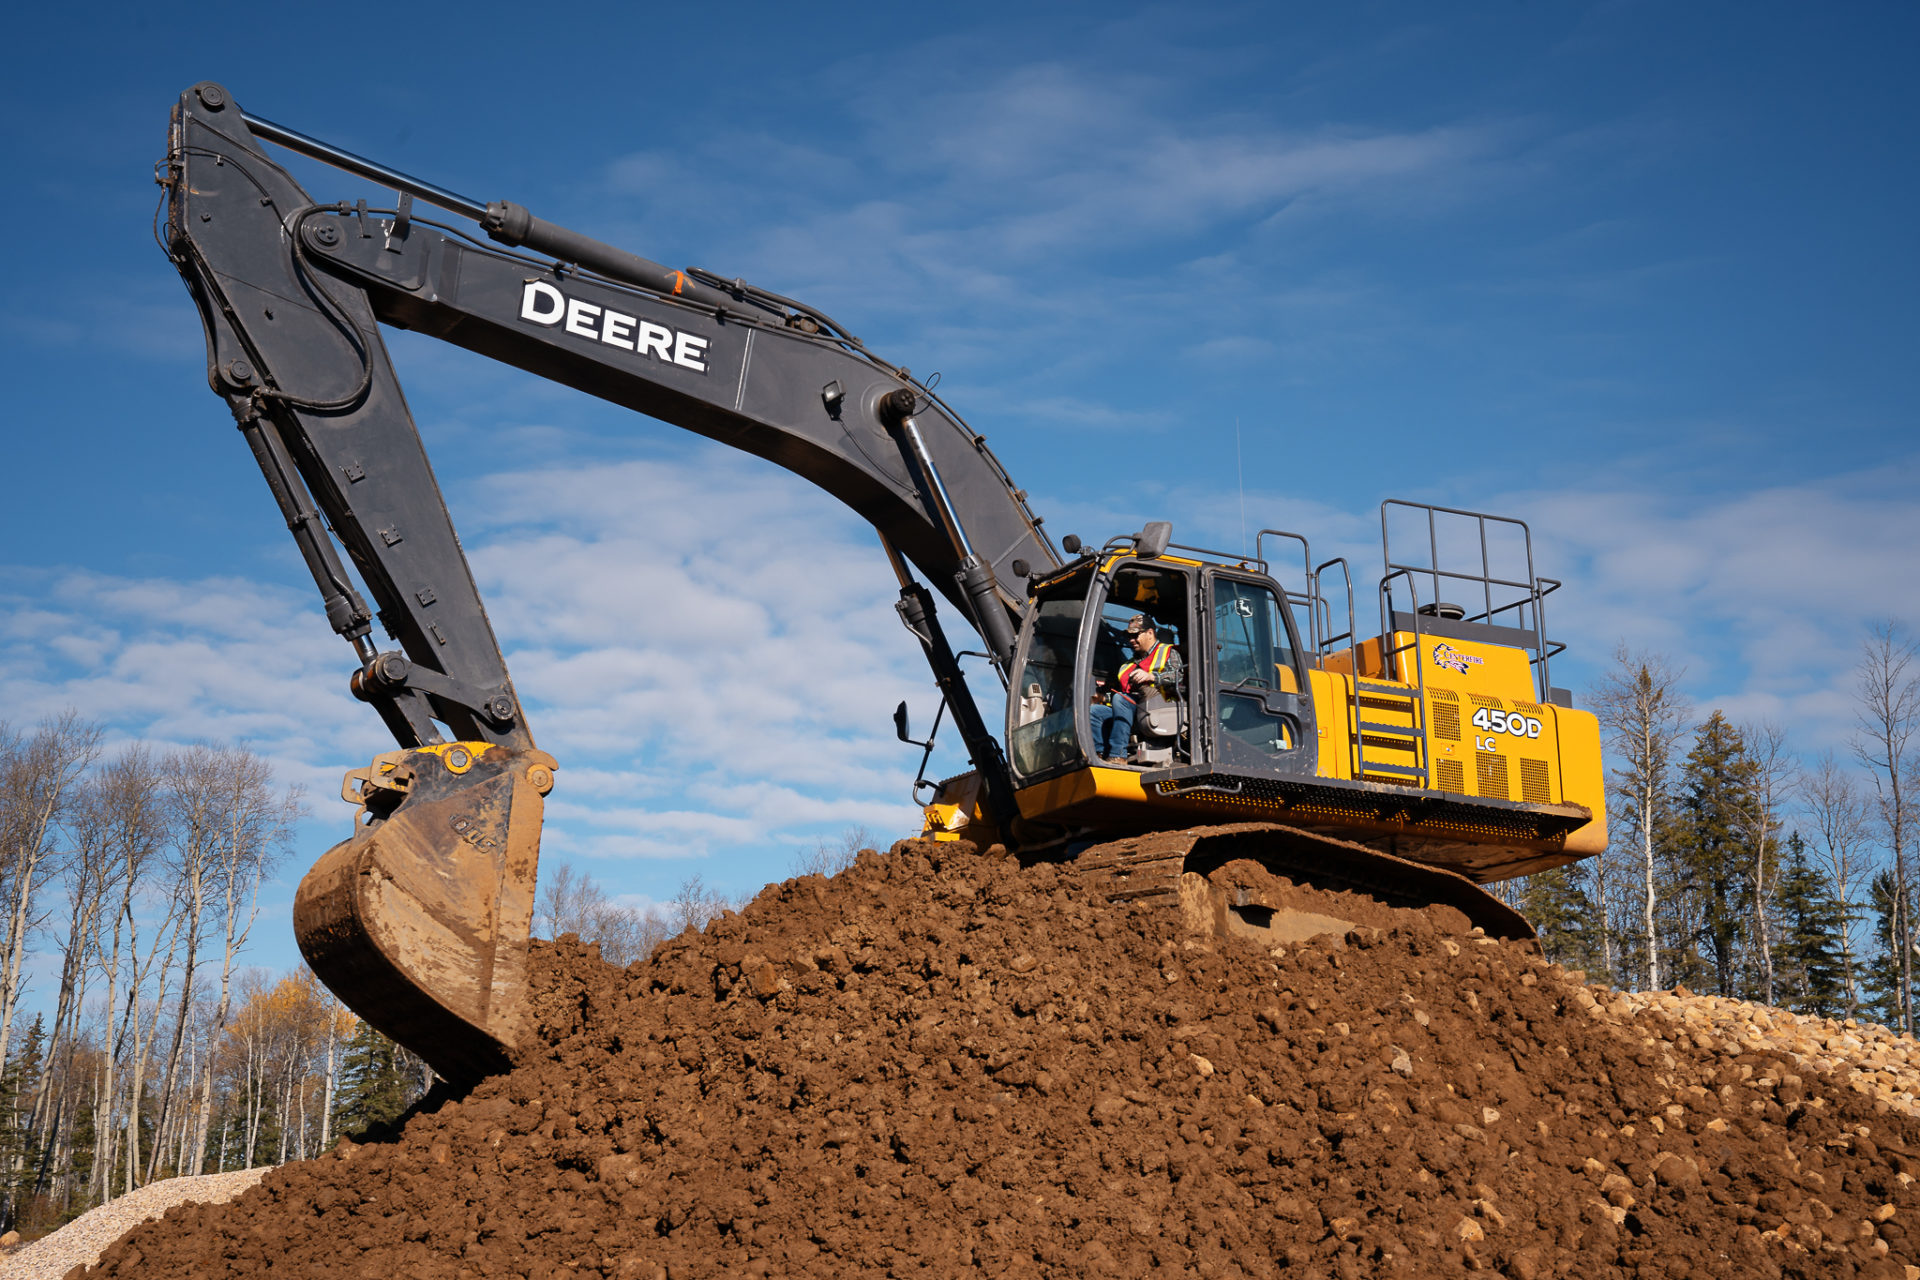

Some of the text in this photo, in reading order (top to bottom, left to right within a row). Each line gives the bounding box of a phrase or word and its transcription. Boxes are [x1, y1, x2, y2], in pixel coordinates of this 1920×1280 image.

[521, 280, 708, 372] DEERE
[1472, 707, 1543, 739] 450D
[1475, 735, 1496, 752] LC
